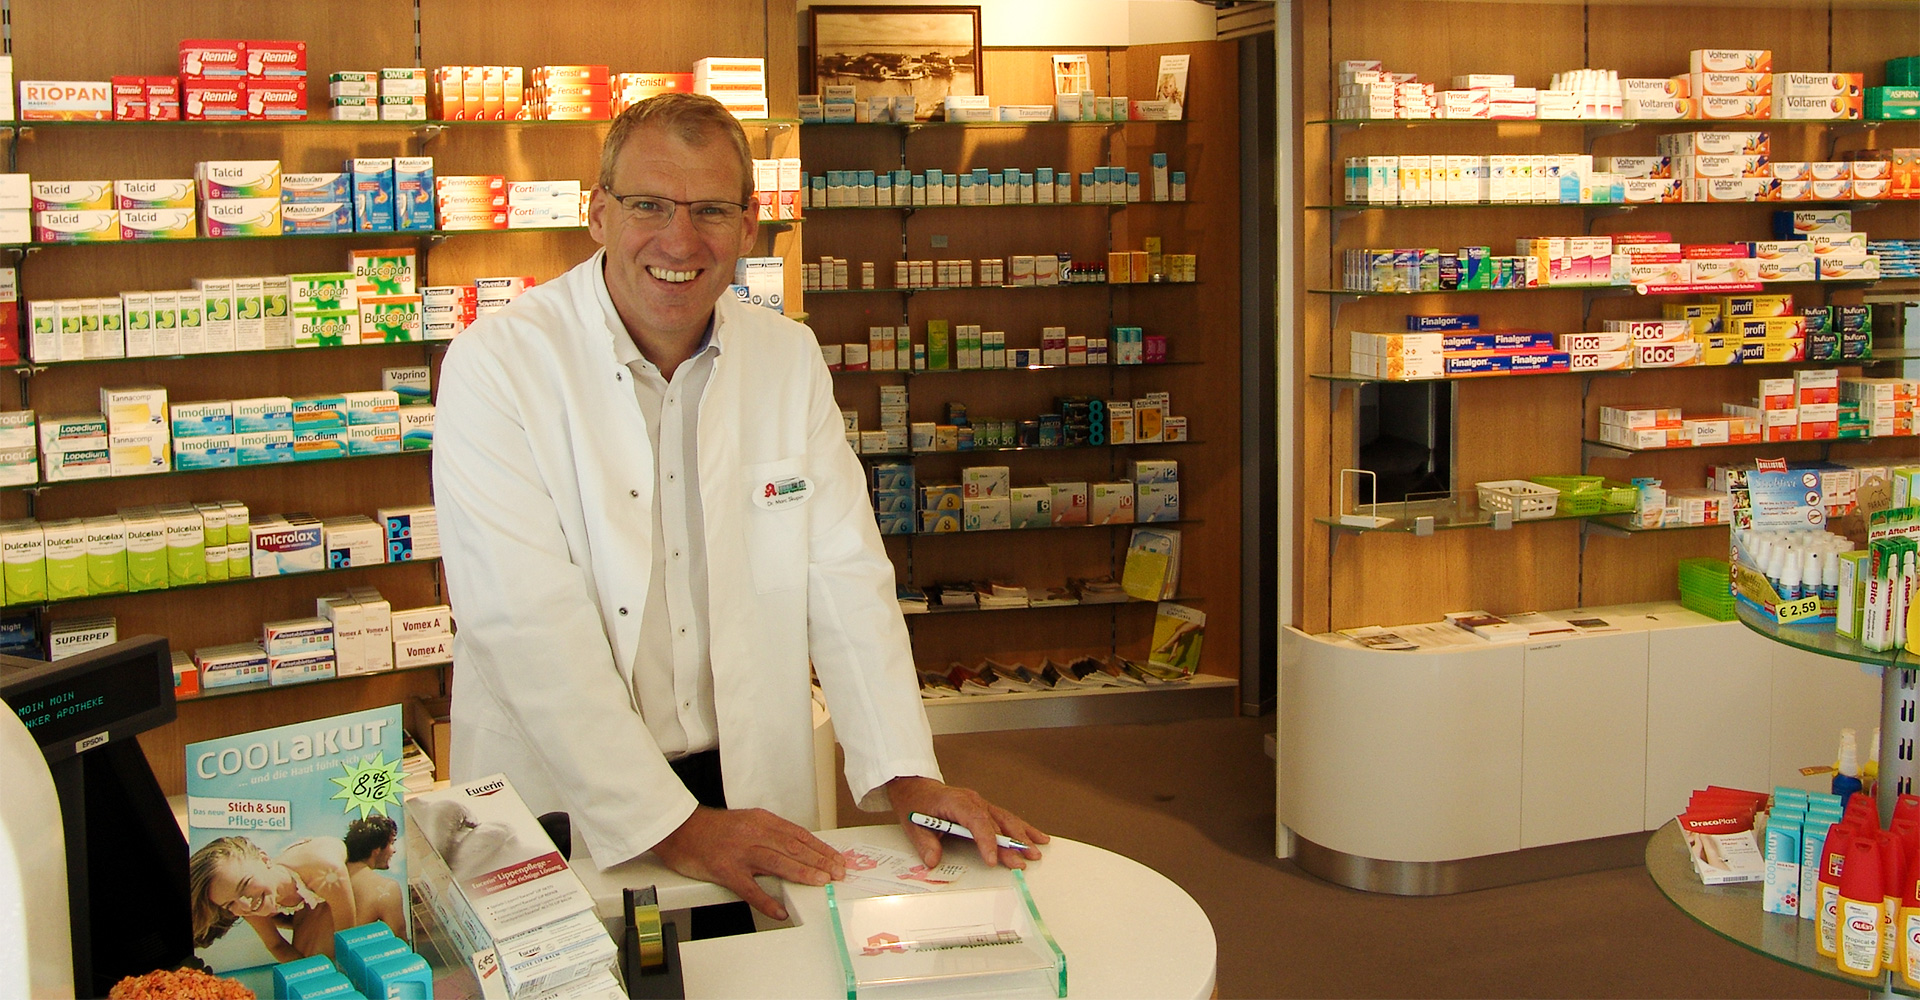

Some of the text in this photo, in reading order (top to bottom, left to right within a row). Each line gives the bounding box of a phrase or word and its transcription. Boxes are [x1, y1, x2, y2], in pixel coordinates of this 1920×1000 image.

[201, 51, 237, 63] Rennie
[263, 52, 297, 63] Rennie
[1708, 51, 1739, 60] Voltaren
[384, 71, 411, 79] OMEP
[556, 68, 580, 77] Fenistil
[635, 78, 667, 87] Fenistil
[1627, 80, 1663, 90] Voltaren
[1708, 75, 1739, 84] Voltaren
[1790, 75, 1829, 85] Voltaren
[27, 86, 107, 101] RIOPAN
[116, 87, 142, 96] Rennie
[150, 87, 175, 96] Rennie
[202, 91, 237, 103] Rennie
[263, 91, 297, 103] Rennie
[1447, 92, 1469, 100] Tyrosur
[1890, 90, 1919, 99] ASPIRIN
[385, 96, 411, 105] OMEP
[1639, 99, 1674, 109] Voltaren
[1708, 97, 1739, 106] Voltaren
[1787, 97, 1827, 108] Voltaren
[1449, 105, 1471, 114] Tyrosur
[357, 160, 389, 168] Maaloxan
[397, 158, 430, 167] Maaloxan
[213, 167, 243, 178] Talcid
[283, 174, 323, 184] Maaloxan
[448, 179, 489, 187] FeniHydrocort
[37, 184, 70, 195] Talcid
[124, 182, 156, 193] Talcid
[514, 184, 550, 194] Cortilind
[451, 197, 491, 205] FeniHydrocort
[213, 205, 243, 216] Talcid
[284, 204, 325, 214] Maaloxan
[514, 207, 550, 217] Cortilind
[46, 214, 79, 224] Talcid
[125, 212, 157, 222] Talcid
[1795, 213, 1815, 224] Kytta
[1809, 235, 1830, 246] Kytta
[1758, 243, 1778, 253] Kytta
[1697, 262, 1717, 271] Kytta
[1760, 262, 1778, 273] Kytta
[1822, 258, 1843, 269] Kytta
[357, 265, 411, 279] Buscopan
[1632, 266, 1651, 275] Kytta
[478, 279, 509, 289] Soventol
[299, 287, 349, 299] Buscopan
[426, 288, 453, 298] Soventol
[425, 306, 453, 315] Soventol
[1687, 308, 1700, 317] proff
[1732, 301, 1753, 314] proff
[1805, 307, 1827, 315] Ibuflam
[1843, 307, 1867, 315] Ibuflam
[365, 312, 419, 325] Buscopan
[1421, 316, 1457, 327] Finalgon
[302, 322, 351, 335] Buscopan
[426, 322, 453, 332] Soventol
[1633, 324, 1663, 339] doc
[1744, 323, 1766, 337] proff
[1443, 337, 1472, 347] nalgon
[1496, 334, 1532, 344] Finalgon
[1577, 337, 1599, 350] doc
[1644, 347, 1674, 362] doc
[1743, 345, 1764, 359] proff
[1451, 357, 1489, 367] Finalgon
[1512, 354, 1549, 364] Finalgon
[1574, 354, 1598, 367] doc
[391, 370, 427, 381] Vaprino
[112, 394, 152, 403] Tannacomp
[351, 397, 396, 409] Imodium
[177, 407, 226, 419] Imodium
[239, 404, 287, 416] Imodium
[295, 402, 337, 413] Imodium
[0, 414, 29, 425] rocur
[61, 424, 103, 434] Lopedium
[352, 426, 396, 438] Imodium
[1698, 427, 1716, 435] Diclo-
[113, 435, 153, 445] Tannacomp
[241, 433, 288, 446] Imodium
[295, 431, 338, 442] Imodium
[988, 437, 998, 446] 50
[181, 439, 230, 451] Imodium
[65, 450, 106, 460] Lopedium
[899, 478, 906, 487] 6
[968, 483, 978, 495] 8
[1041, 500, 1050, 510] 6
[128, 529, 164, 541] Dulcolax
[167, 524, 202, 535] Dulcolax
[1888, 528, 1909, 536] After
[47, 536, 84, 547] Dulcolax
[87, 532, 124, 544] Dulcolax
[260, 531, 316, 547] microlax
[4, 540, 42, 551] Dulcolax
[1870, 580, 1879, 605] Bite
[1780, 601, 1816, 618] € 2,59
[402, 618, 440, 632] Vomex A
[1884, 608, 1892, 631] Bite
[1, 622, 21, 633] Night
[366, 625, 389, 635] Vomex A
[55, 632, 109, 646] SUPERPEP
[278, 630, 315, 640] Reisetabletten
[407, 645, 436, 658] Vomex
[279, 657, 316, 668] Reisetabletten
[18, 690, 75, 717] MOIN MOIN
[25, 695, 104, 729] NKER APOTHEKE
[82, 735, 104, 749] EPSON
[250, 773, 270, 785] und
[272, 769, 288, 780] die
[291, 764, 314, 776] Haut
[316, 758, 340, 771] fühlt
[465, 779, 505, 797] Eucerin
[193, 808, 206, 816] Das
[228, 801, 286, 814] Stich & Sun
[228, 814, 286, 828] Pflege-Gel
[1689, 818, 1738, 828] DracoPlast
[472, 860, 547, 889] Eucerin Lippenpflege
[486, 883, 507, 893] immer
[507, 878, 518, 886] die
[518, 872, 540, 883] richtige
[1822, 919, 1836, 928] Trop
[1845, 935, 1870, 945] Tropical
[515, 962, 533, 971] ACUTE
[545, 952, 560, 961] BALM
